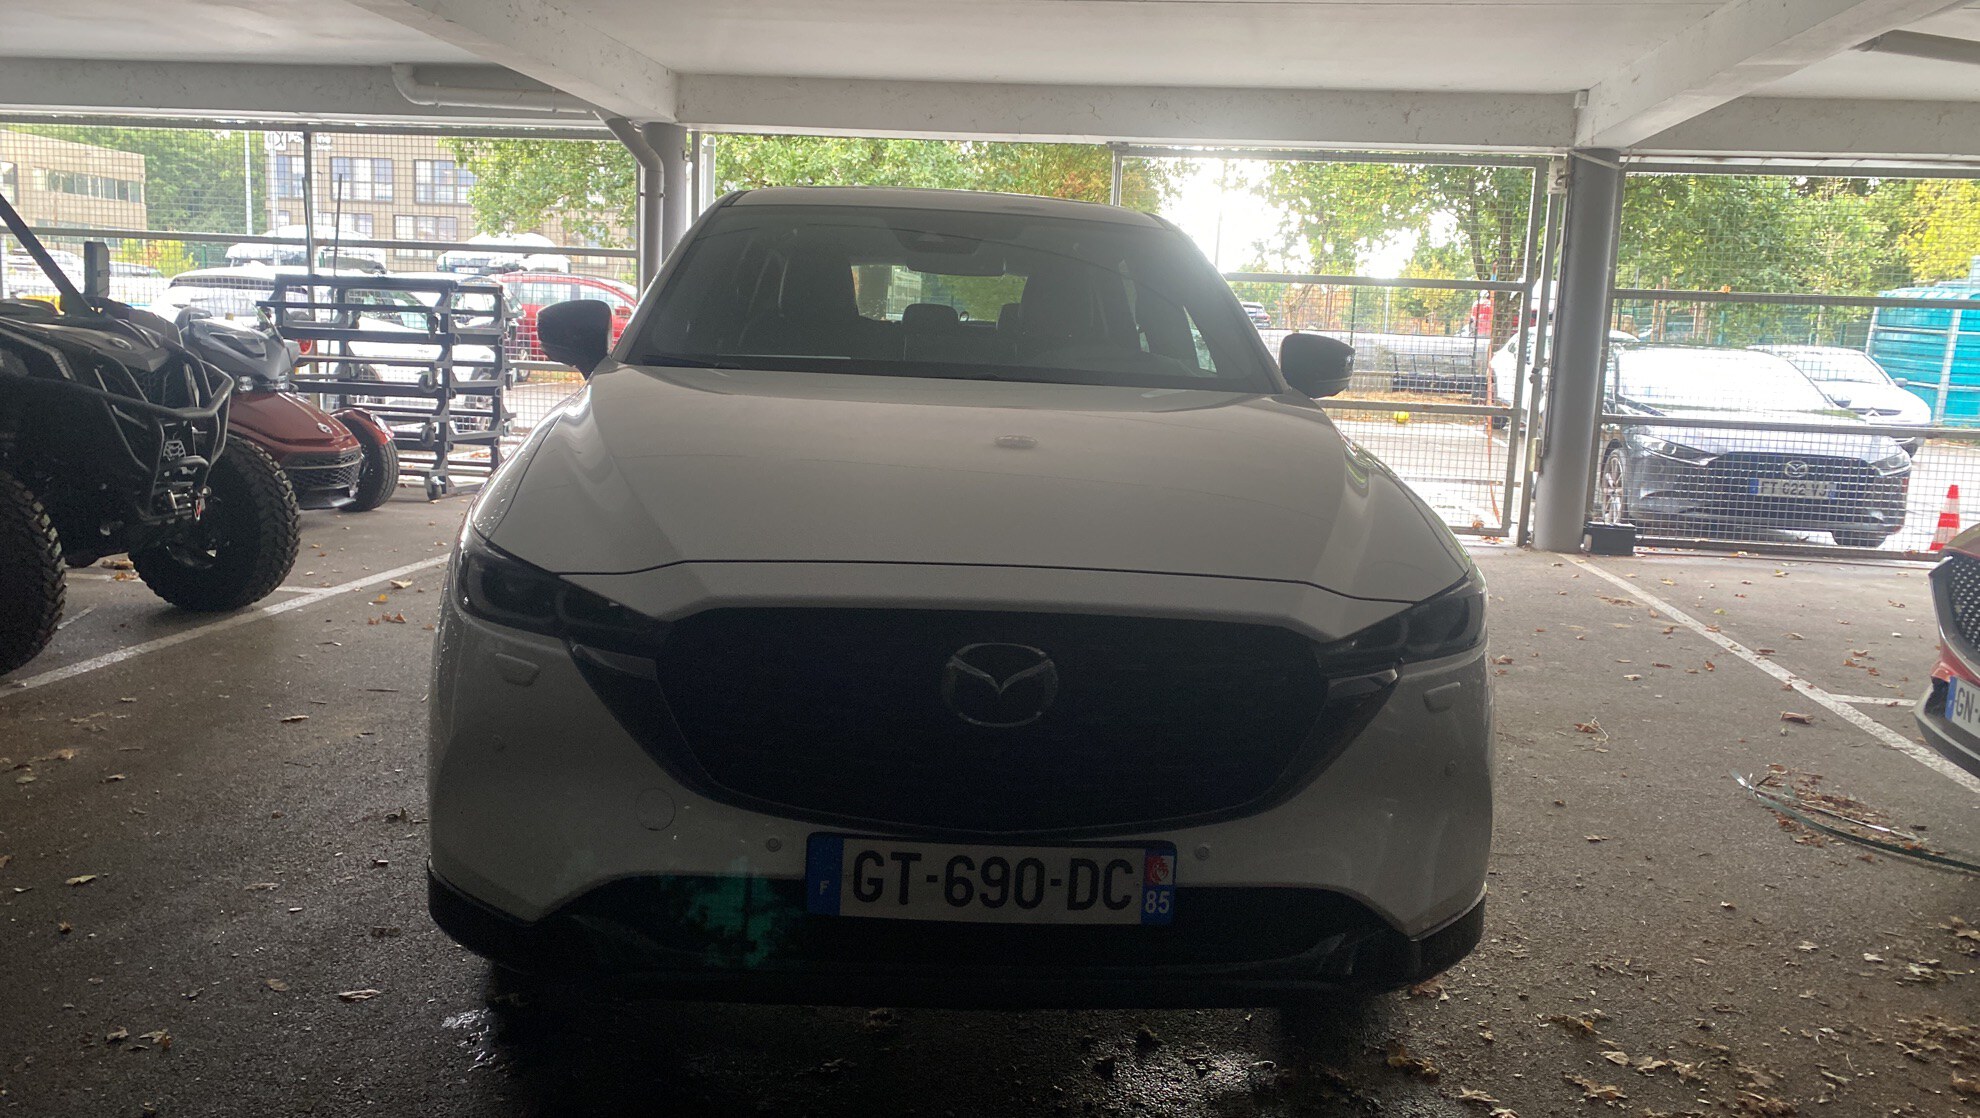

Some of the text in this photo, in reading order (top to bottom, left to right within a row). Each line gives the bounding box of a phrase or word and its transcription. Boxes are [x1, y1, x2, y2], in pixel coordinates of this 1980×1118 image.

[1955, 687, 1980, 723] GN-
[819, 850, 1170, 913] F GT-690-DC 85
